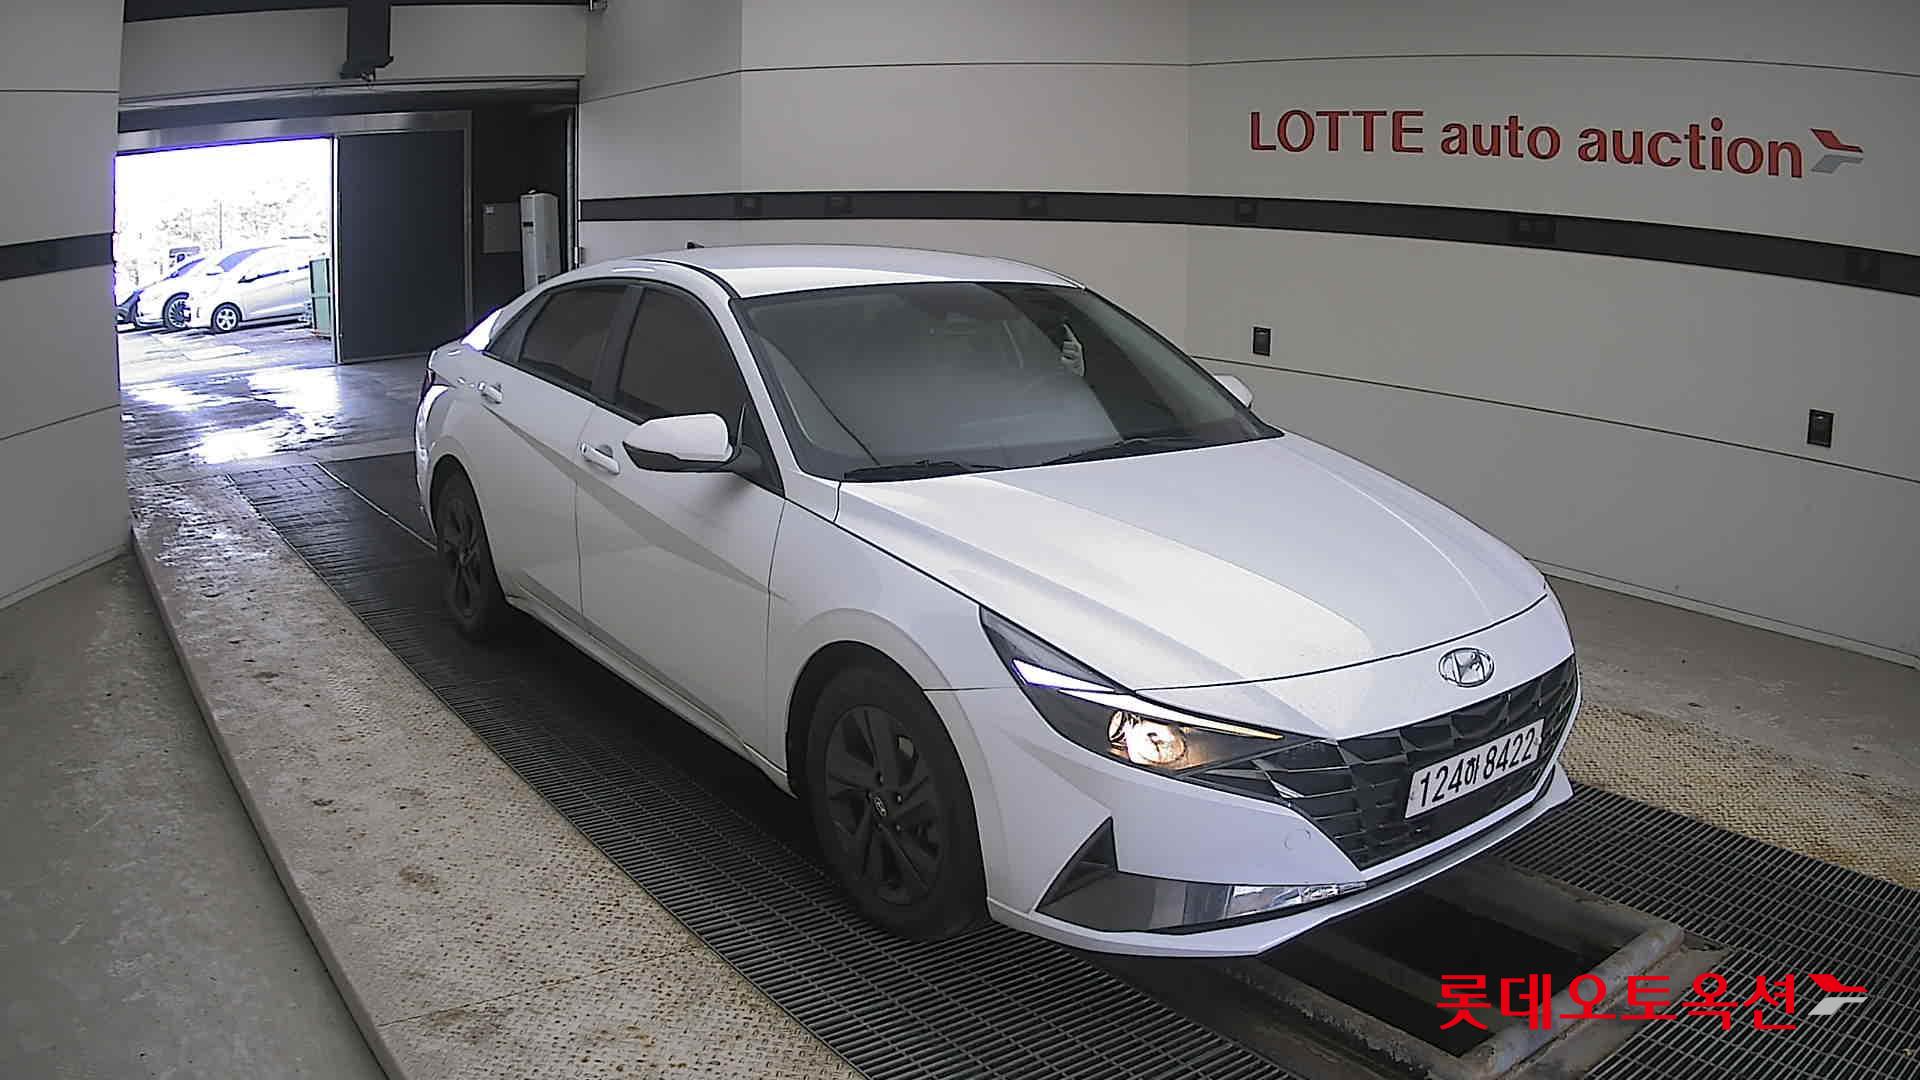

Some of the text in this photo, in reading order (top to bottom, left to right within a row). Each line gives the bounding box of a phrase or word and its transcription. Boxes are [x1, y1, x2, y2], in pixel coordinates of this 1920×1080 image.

[1250, 109, 1803, 179] LOTTE auto auction
[1483, 727, 1536, 780] 8422
